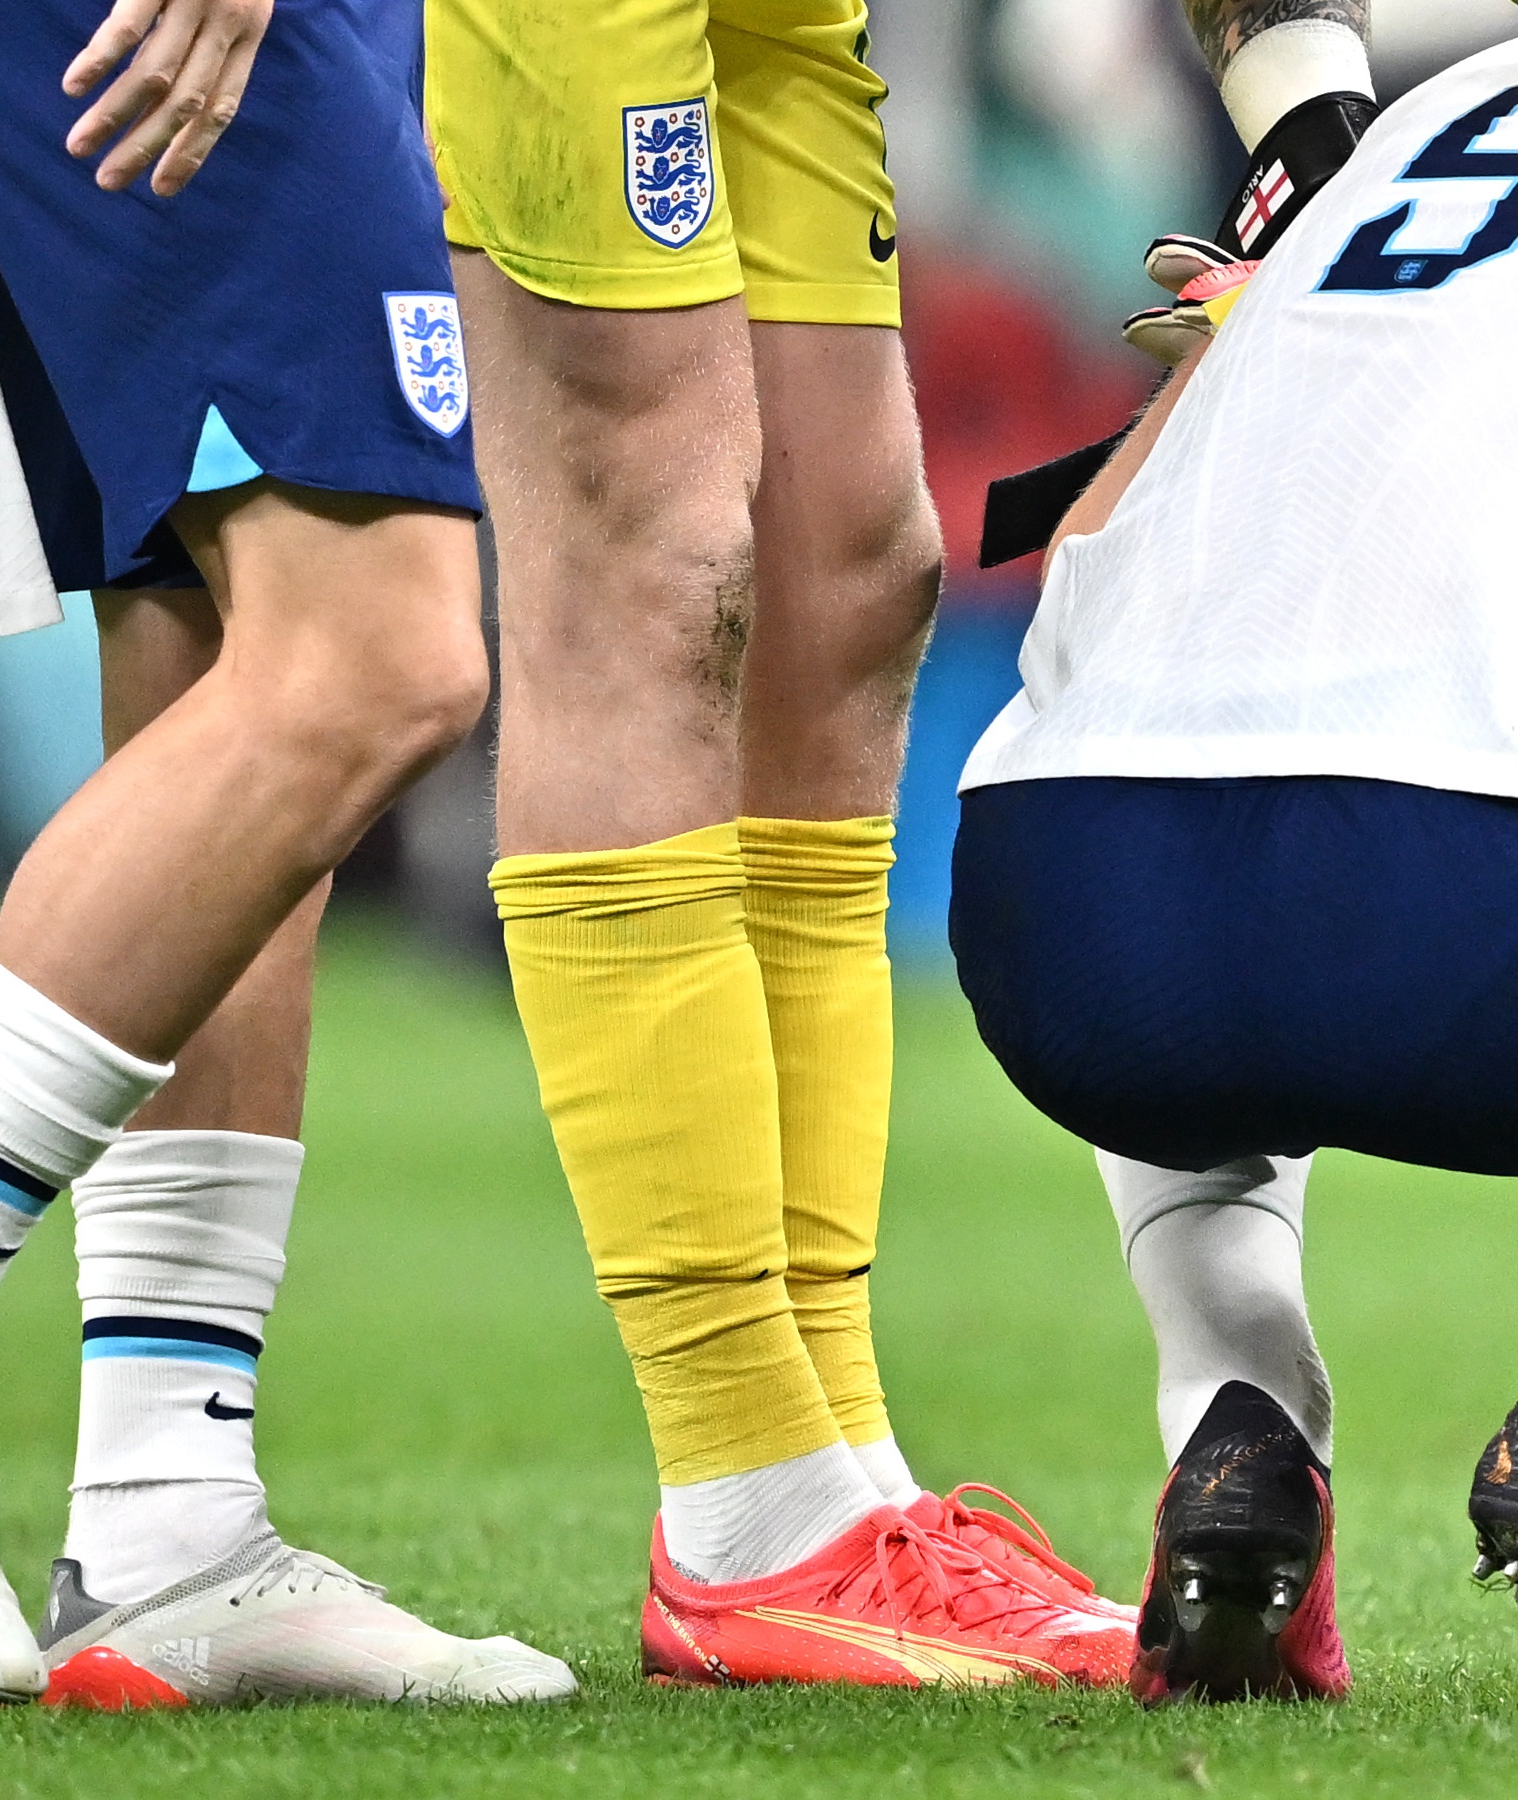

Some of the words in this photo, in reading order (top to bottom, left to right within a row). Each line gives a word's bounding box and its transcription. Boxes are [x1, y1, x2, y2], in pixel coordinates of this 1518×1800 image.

[1242, 163, 1263, 203] ARLO
[152, 1643, 210, 1686] adidas
[694, 1647, 708, 1662] ON
